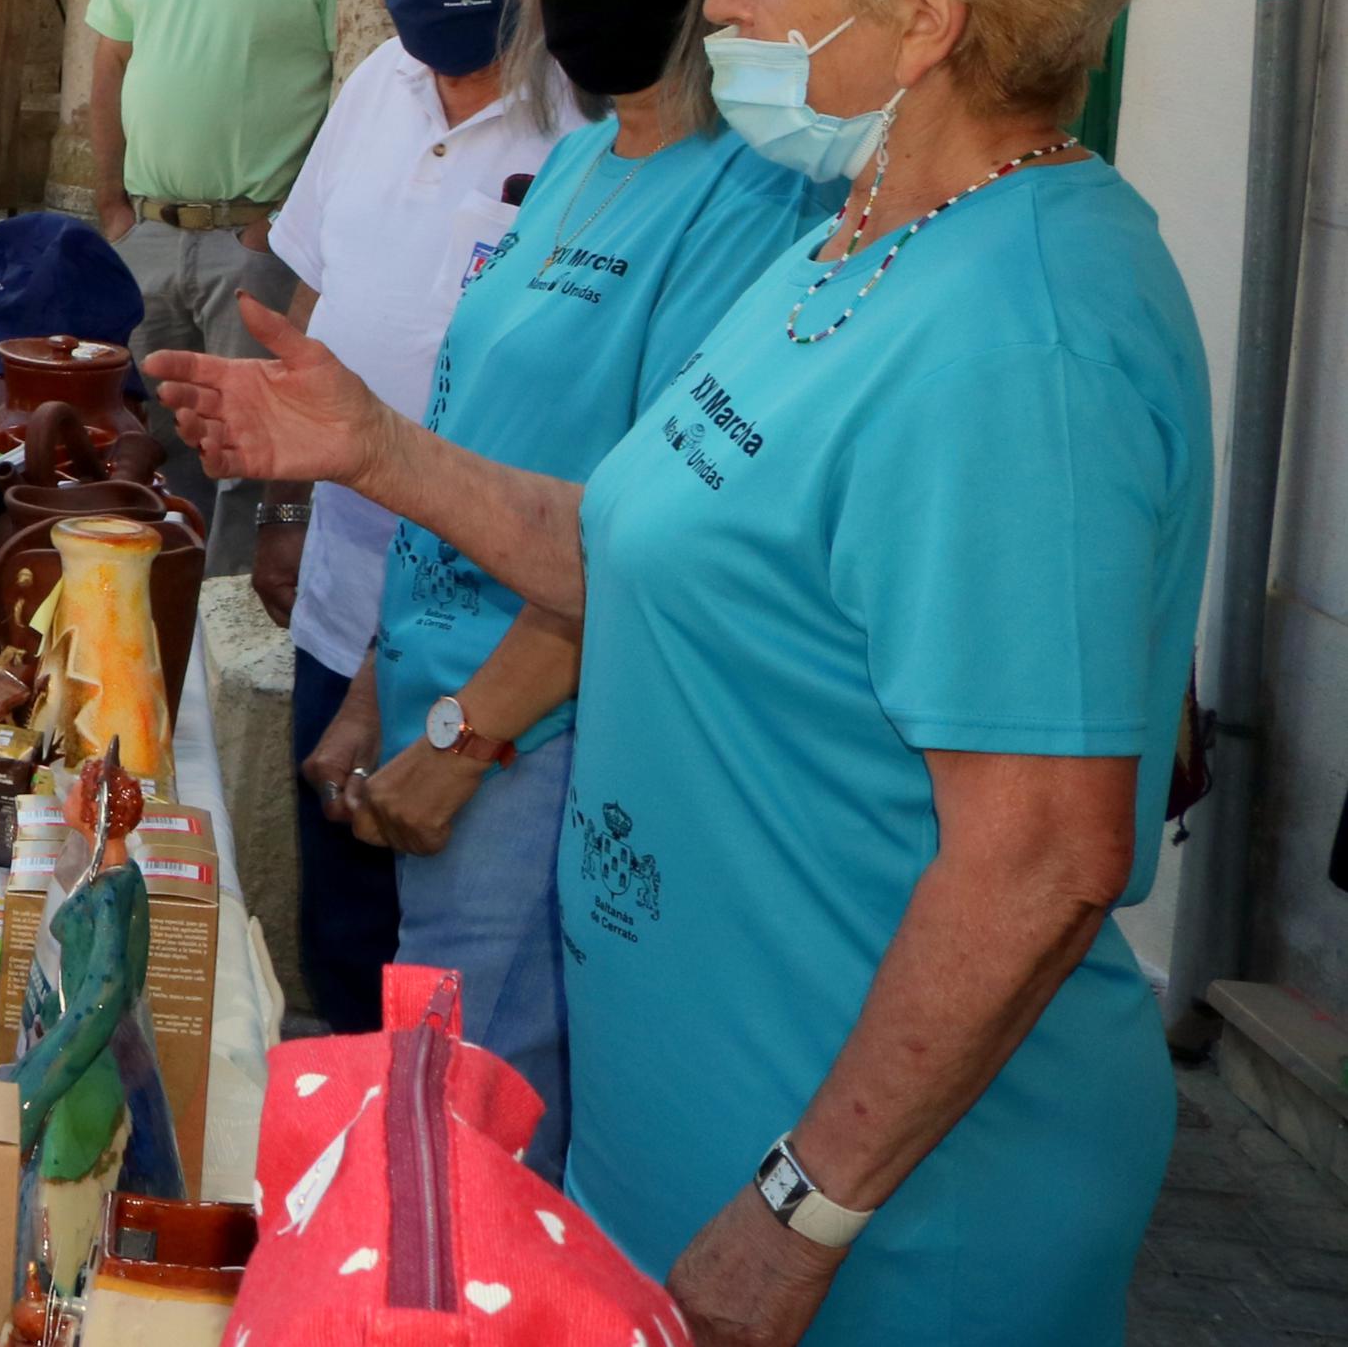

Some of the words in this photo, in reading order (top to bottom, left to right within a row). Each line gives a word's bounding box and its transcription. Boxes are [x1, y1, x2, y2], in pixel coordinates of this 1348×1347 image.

[701, 388, 764, 458] Marcha
[686, 448, 725, 491] Unidas
[601, 916, 639, 944] Cerrato
